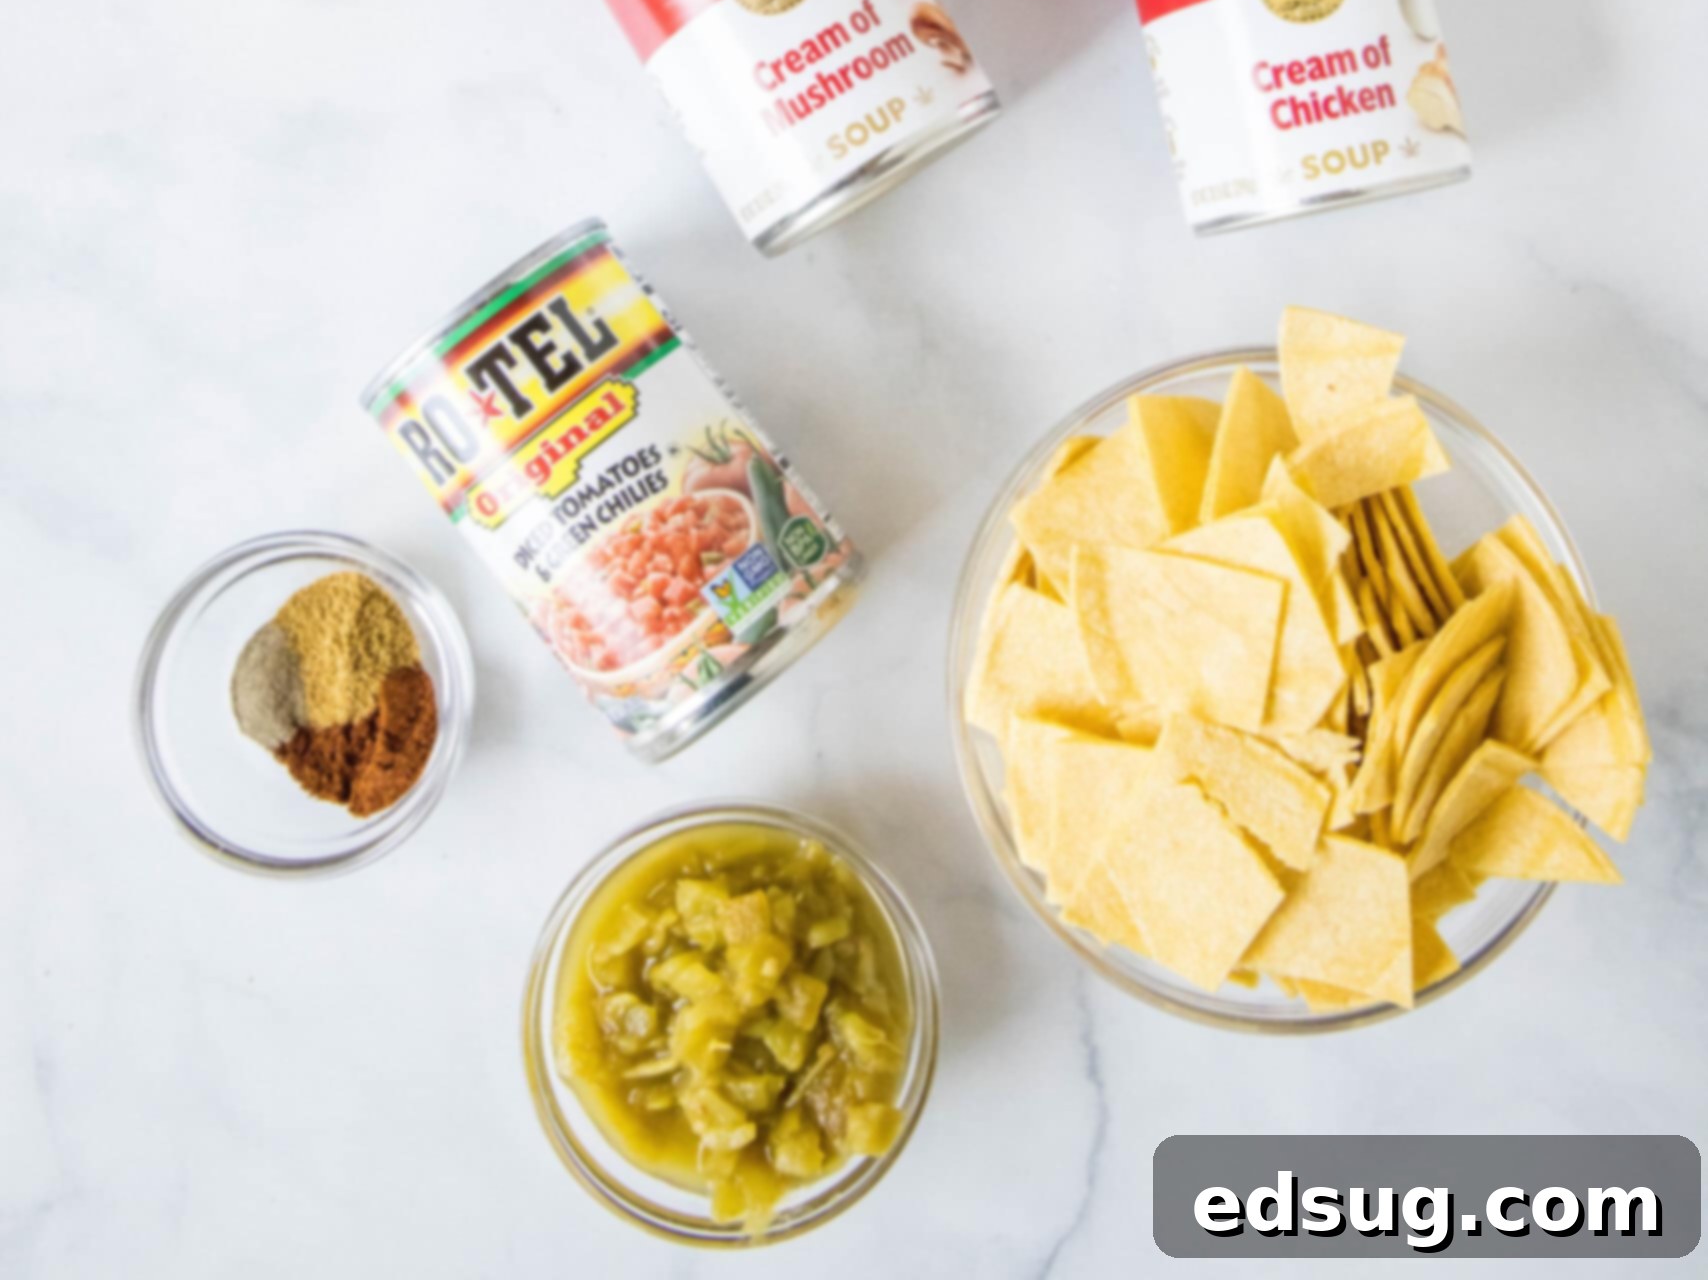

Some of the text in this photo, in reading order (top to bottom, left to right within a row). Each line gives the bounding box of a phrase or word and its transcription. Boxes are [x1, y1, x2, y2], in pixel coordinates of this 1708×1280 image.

[753, 20, 851, 91] Cream
[761, 32, 916, 137] Mushroom
[1252, 34, 1392, 93] Cream of
[826, 97, 906, 160] SOUP
[1270, 81, 1396, 131] Chicken
[1300, 139, 1391, 181] SOUP
[475, 391, 627, 518] Original
[552, 444, 662, 525] TOMATOES
[596, 469, 669, 525] CHILIES
